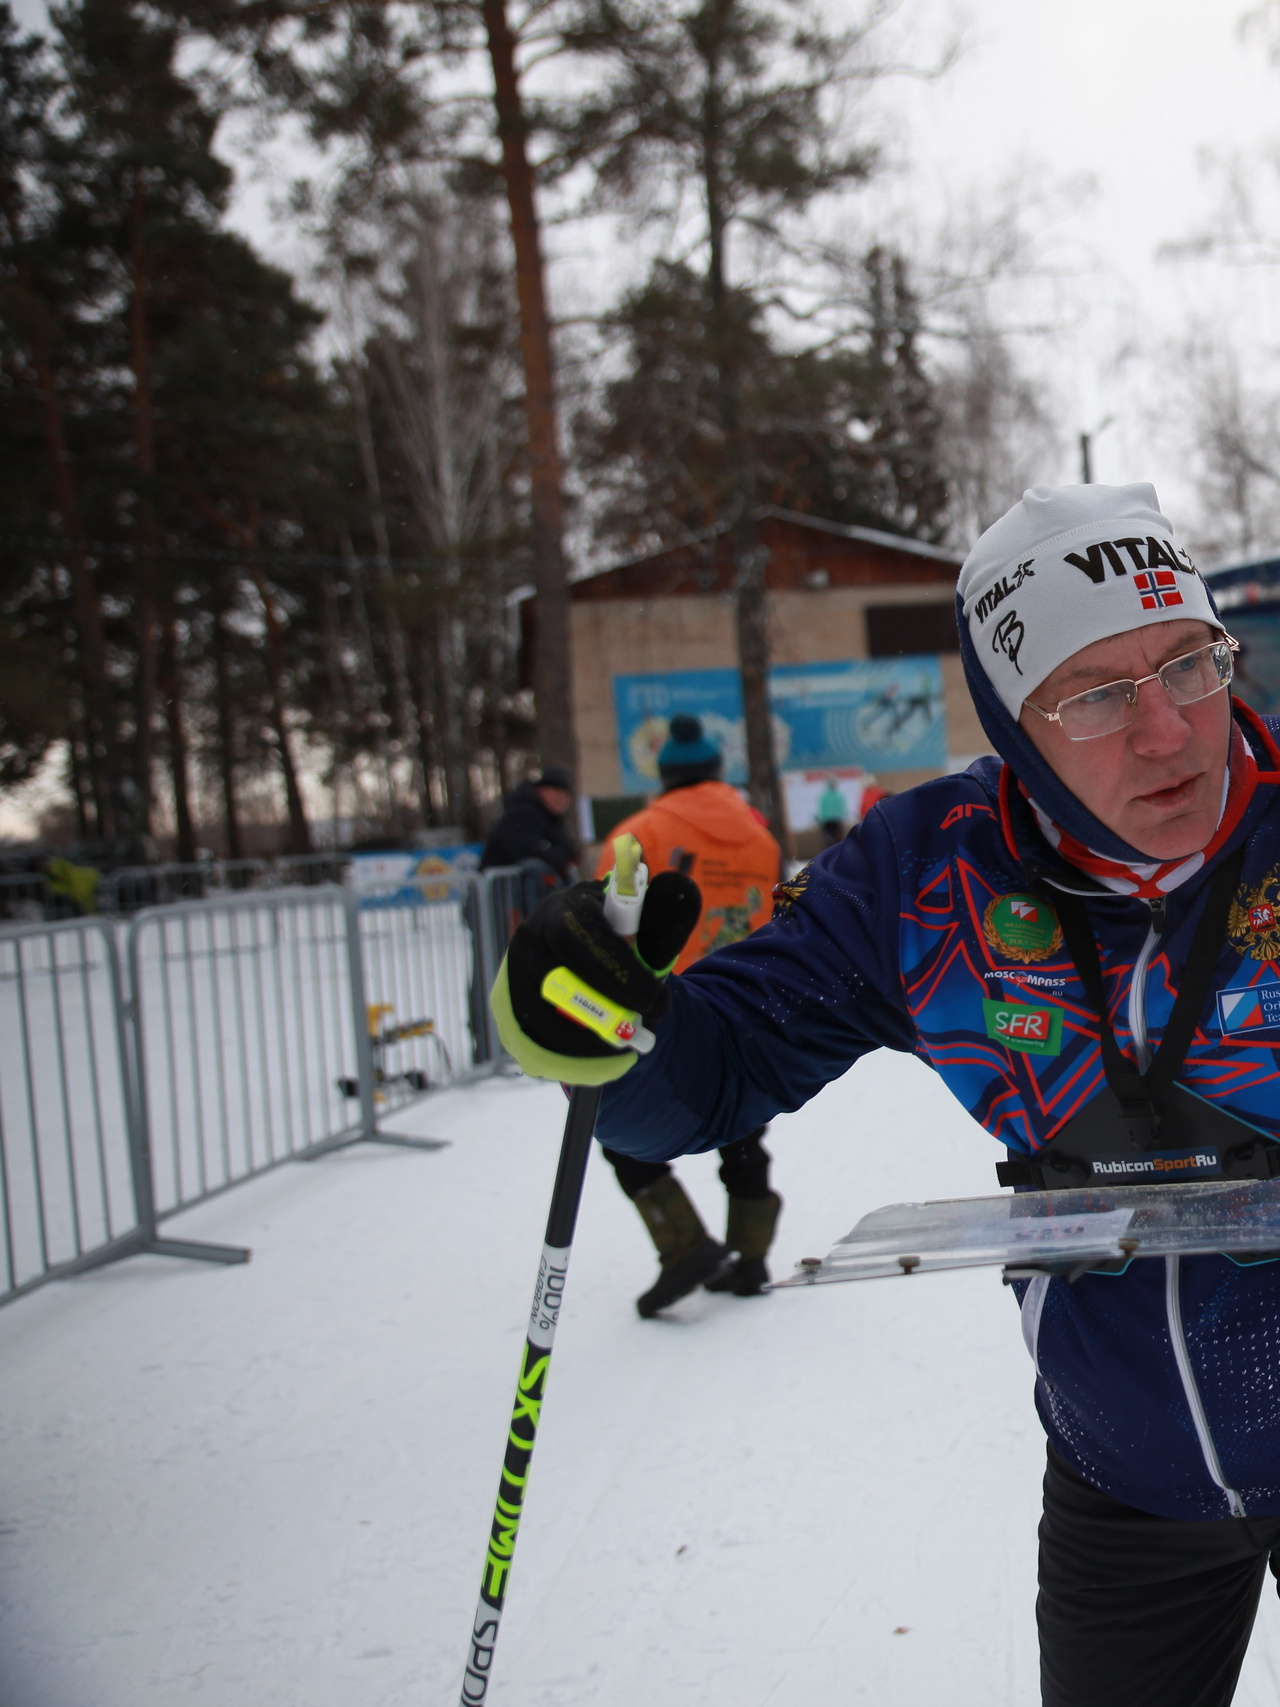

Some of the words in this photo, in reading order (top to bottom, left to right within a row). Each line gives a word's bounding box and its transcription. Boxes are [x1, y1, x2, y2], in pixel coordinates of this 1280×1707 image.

[994, 1011, 1043, 1036] SFR
[1093, 1154, 1217, 1174] RubiconSportRu
[530, 1255, 548, 1324] CARBON
[540, 1262, 568, 1330] 100%
